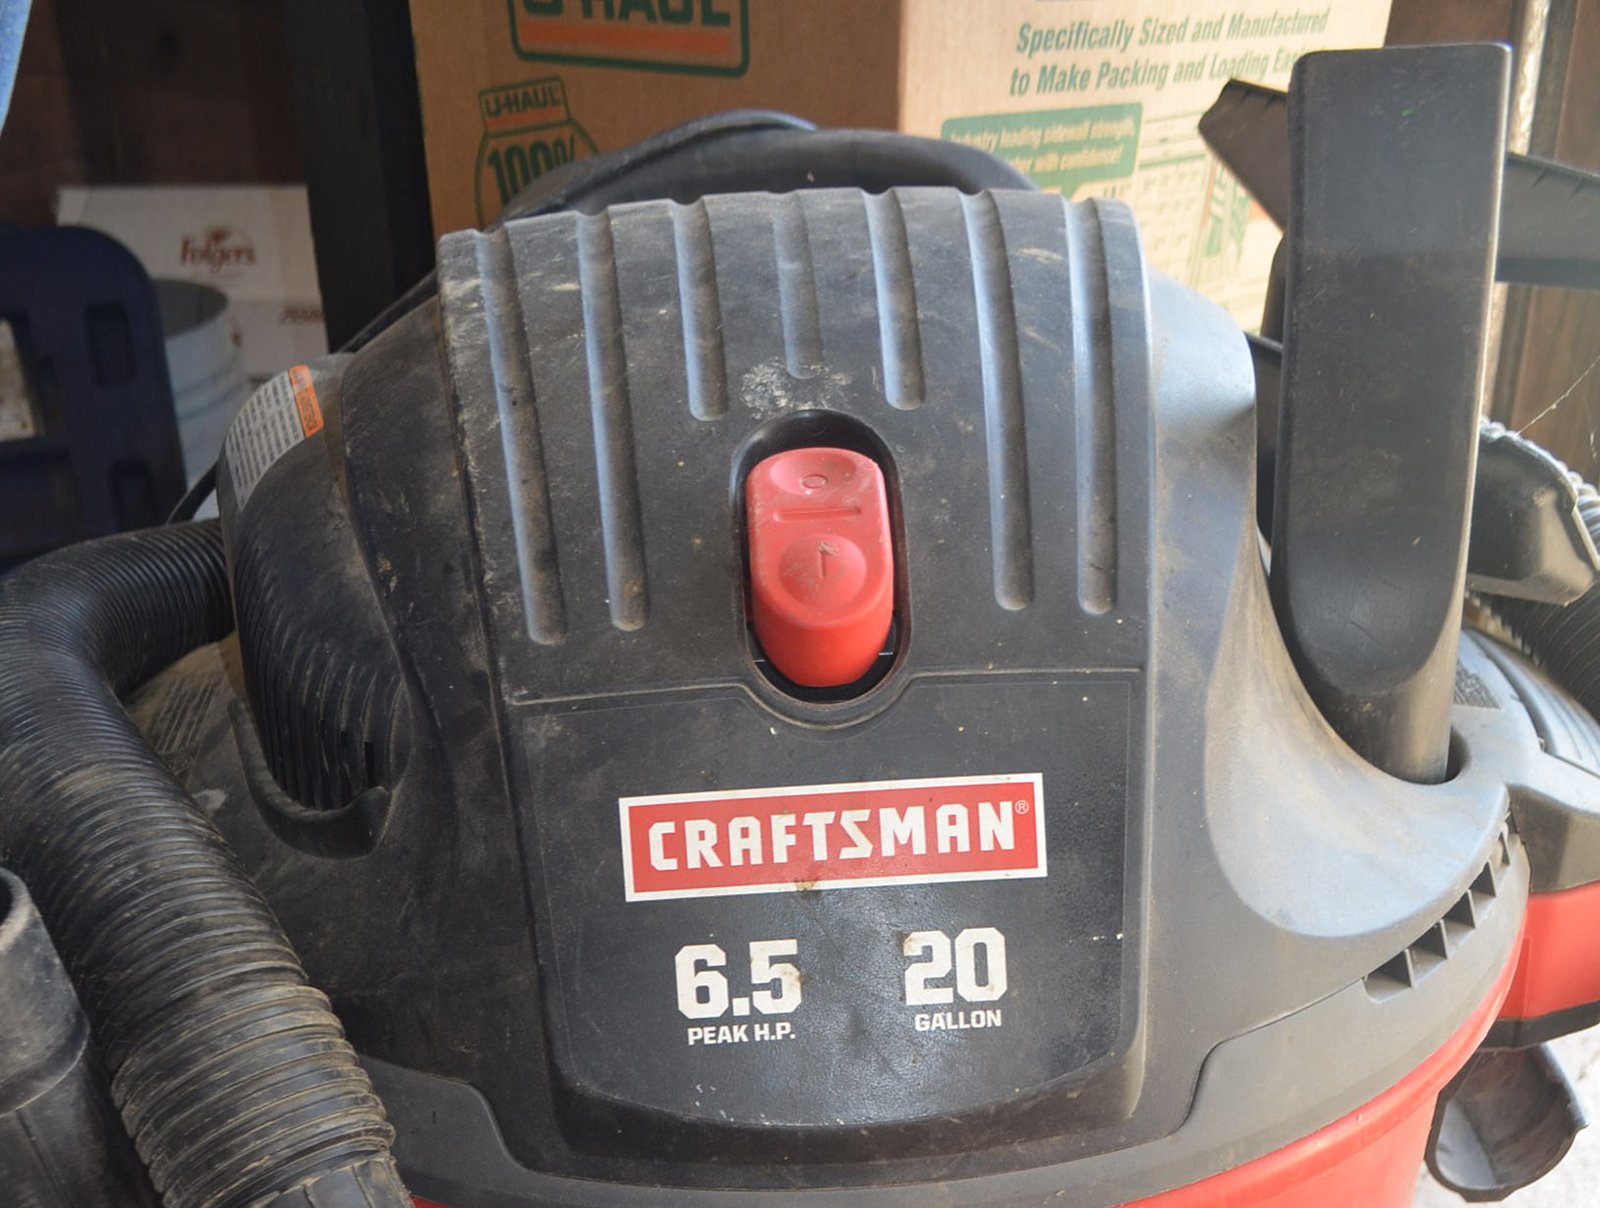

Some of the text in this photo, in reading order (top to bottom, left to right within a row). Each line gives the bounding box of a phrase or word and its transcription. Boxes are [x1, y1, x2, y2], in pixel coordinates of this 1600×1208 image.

[1016, 8, 1331, 60] Specifically Sized and Manufactured
[1010, 67, 1031, 96] to
[1036, 63, 1092, 94] Make
[1096, 58, 1170, 92] Packing
[1173, 55, 1207, 84] and
[1208, 49, 1271, 81] Loading
[648, 800, 1015, 872] CRAFTSMAN
[674, 927, 1009, 1020] 6.5 20
[687, 1021, 797, 1046] PEAK H.P.
[914, 1009, 1002, 1032] GALLON
